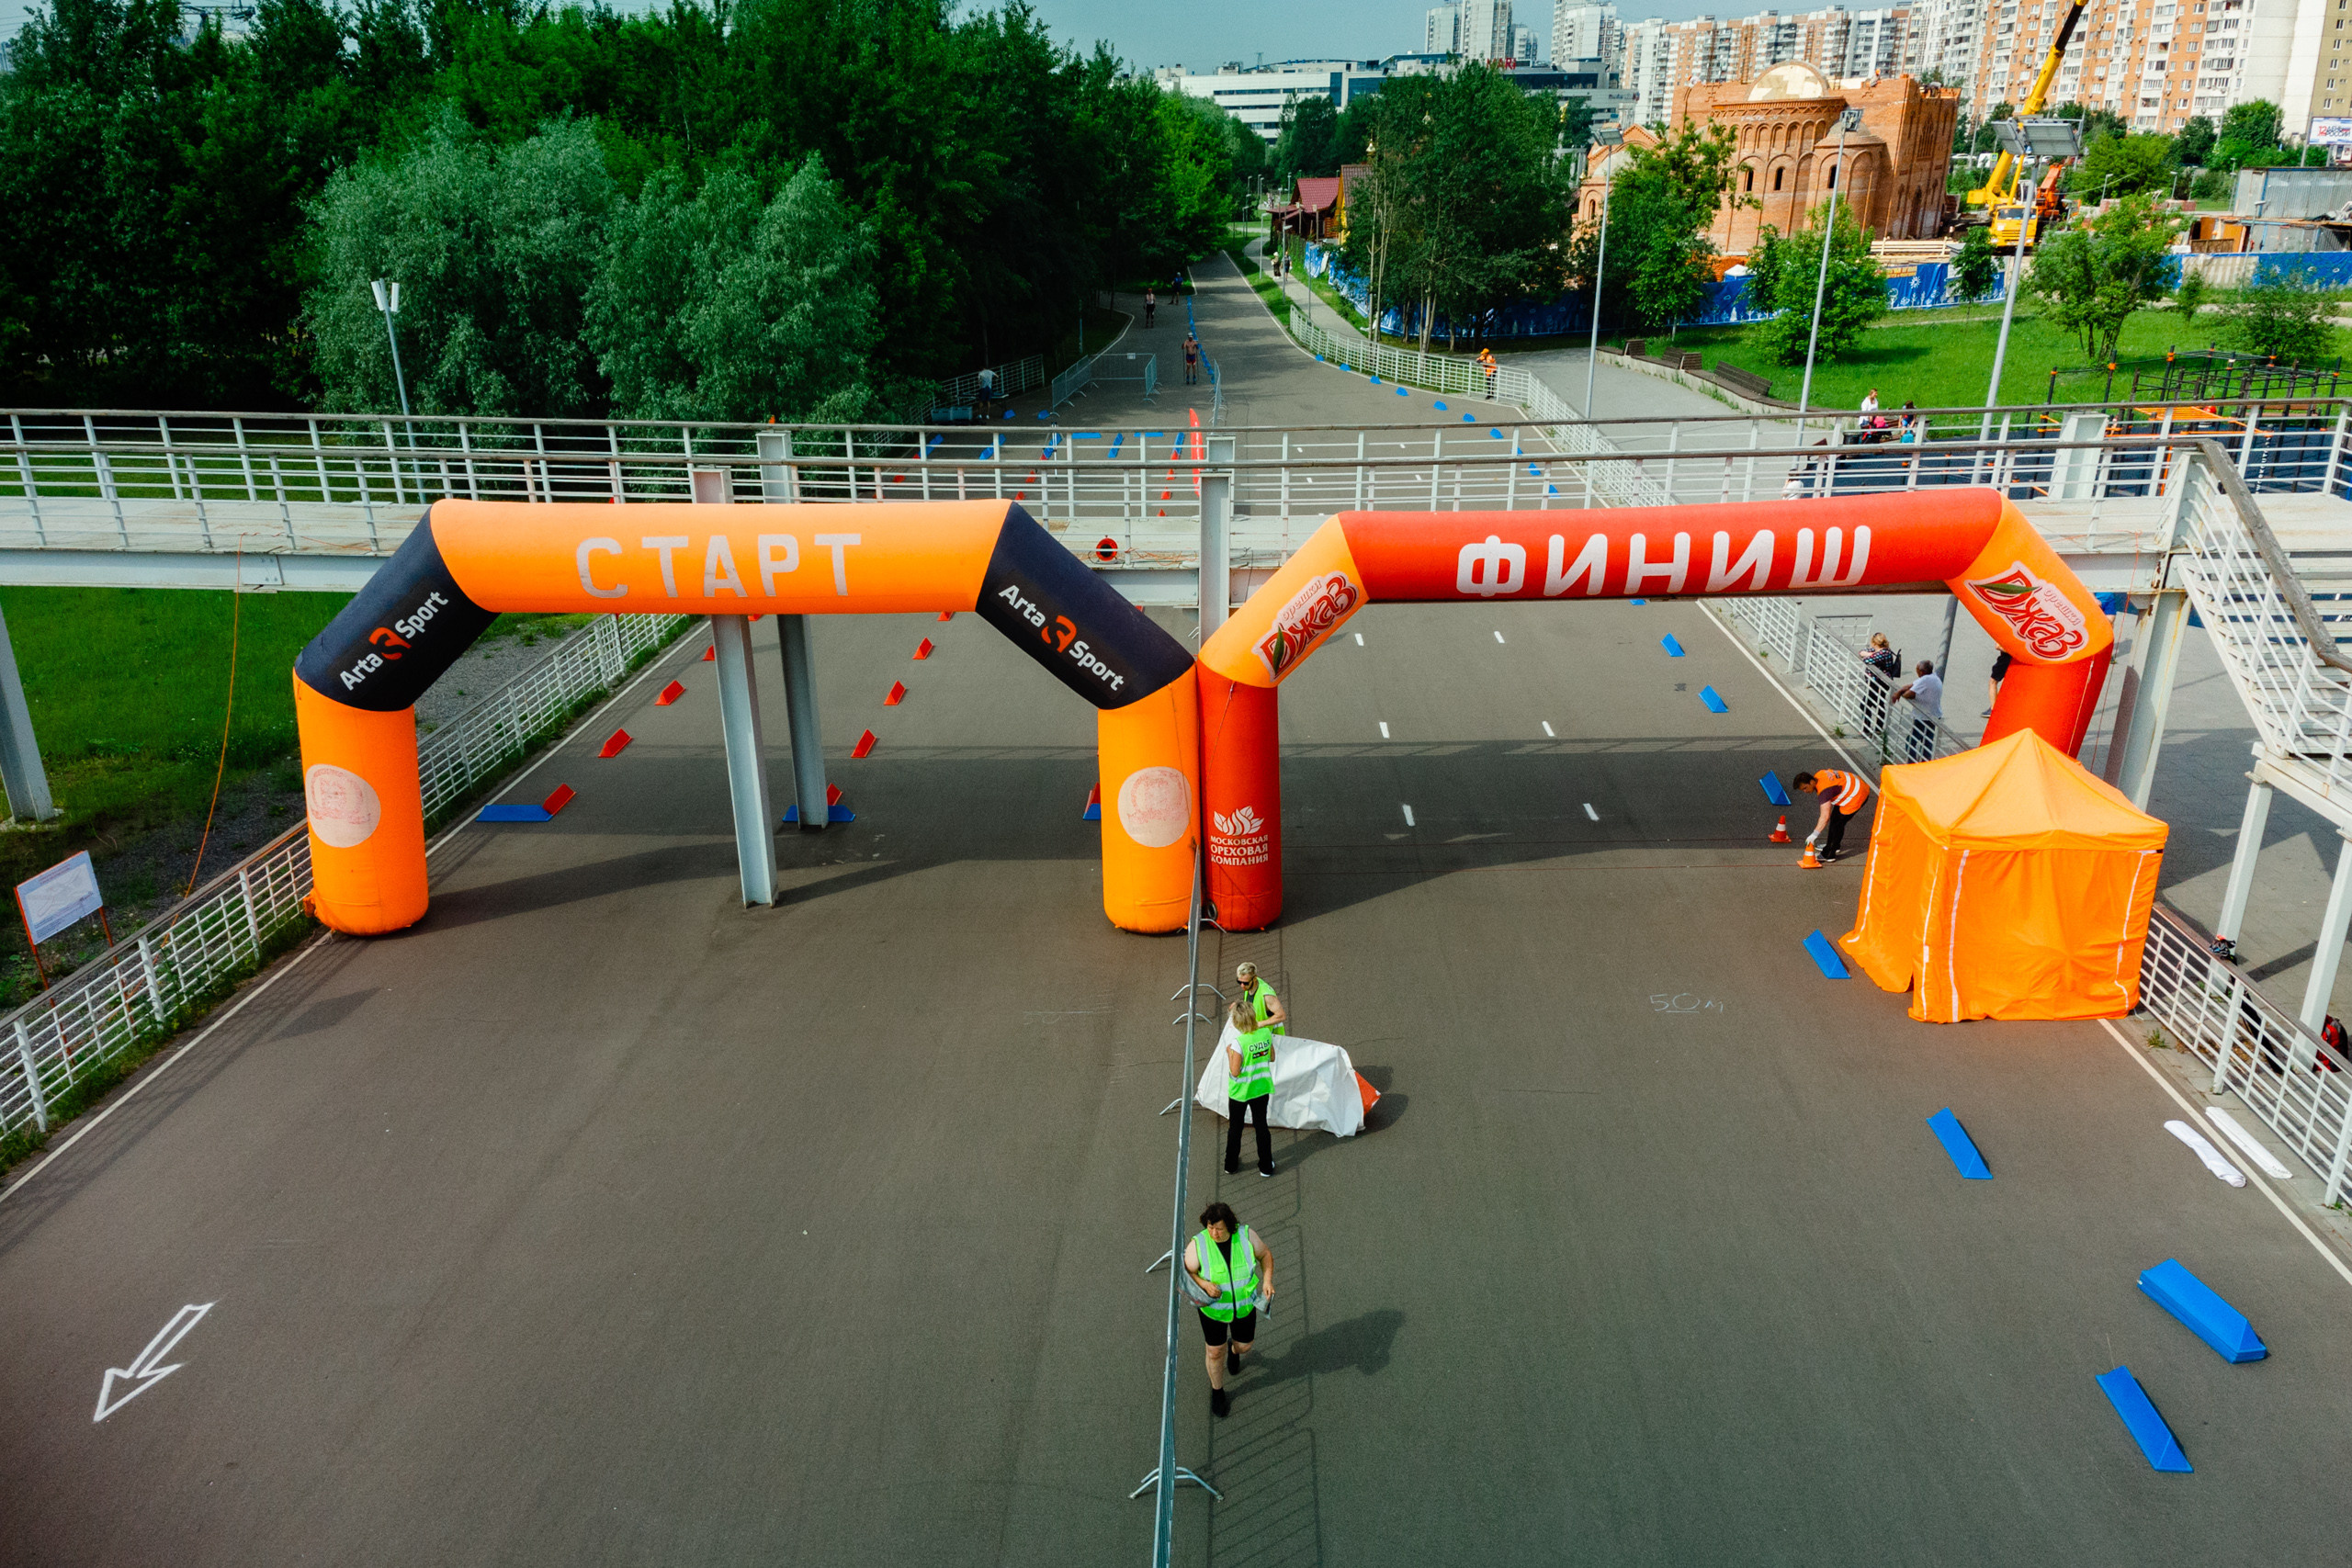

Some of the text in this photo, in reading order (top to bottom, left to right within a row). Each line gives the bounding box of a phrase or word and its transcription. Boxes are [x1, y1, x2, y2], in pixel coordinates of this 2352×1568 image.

[576, 533, 862, 598] СТАРТ
[1456, 525, 1871, 597] ФИНИШ
[340, 592, 448, 691] Arta Sport
[998, 584, 1124, 691] Arta Sport
[1210, 834, 1268, 846] МОСКОВСКАЯ
[1210, 843, 1268, 856] ОРЕХОВАЯ
[1211, 853, 1268, 866] КОМПАНИЯ
